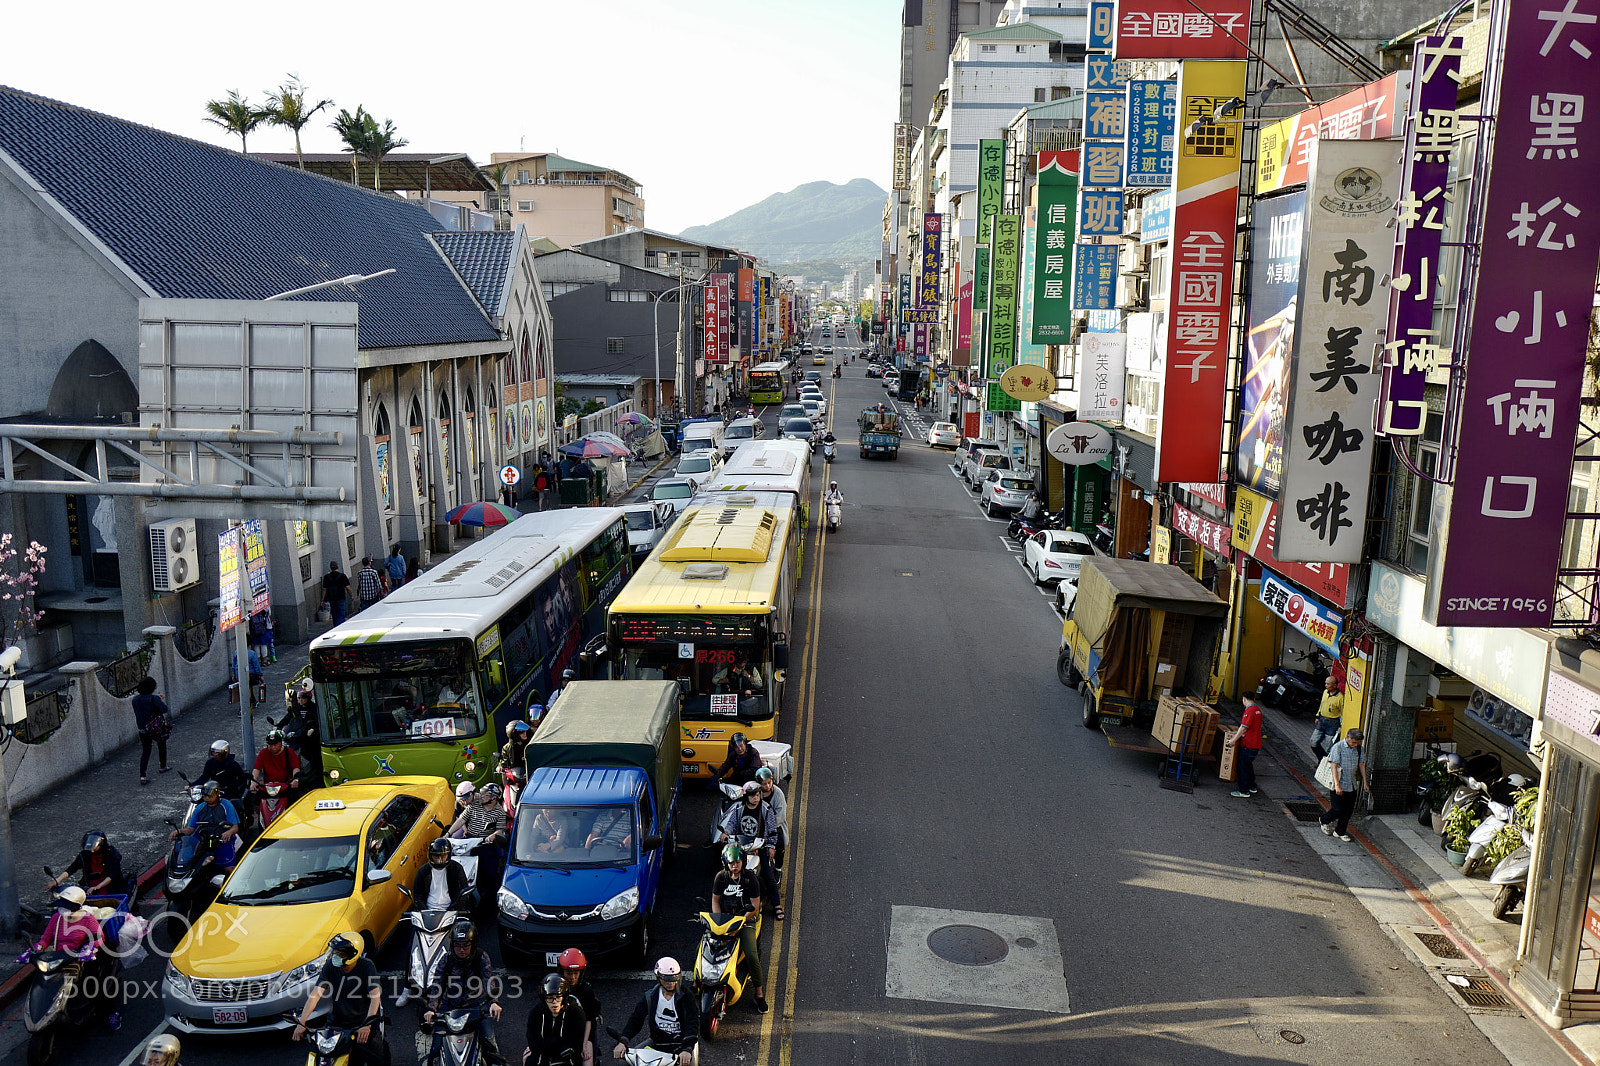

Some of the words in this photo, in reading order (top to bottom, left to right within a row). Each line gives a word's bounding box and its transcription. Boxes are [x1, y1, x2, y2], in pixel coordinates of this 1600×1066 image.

[1120, 11, 1245, 38] 全國電子
[1141, 83, 1160, 173] 數理一對一班
[896, 147, 905, 181] HOTEL
[1043, 203, 1067, 299] 信義房屋
[1384, 36, 1470, 436] 大黑松小倆口
[1480, 0, 1598, 519] 大黑松小倆口
[705, 288, 718, 356] 義興五金行
[1174, 230, 1226, 384] 全國電子
[1094, 353, 1109, 409] 芙洛拉
[1296, 238, 1375, 547] 南美咖啡
[1053, 443, 1070, 454] La
[1446, 597, 1501, 611] SINCE
[1502, 597, 1548, 612] 1956
[423, 719, 453, 736] 601
